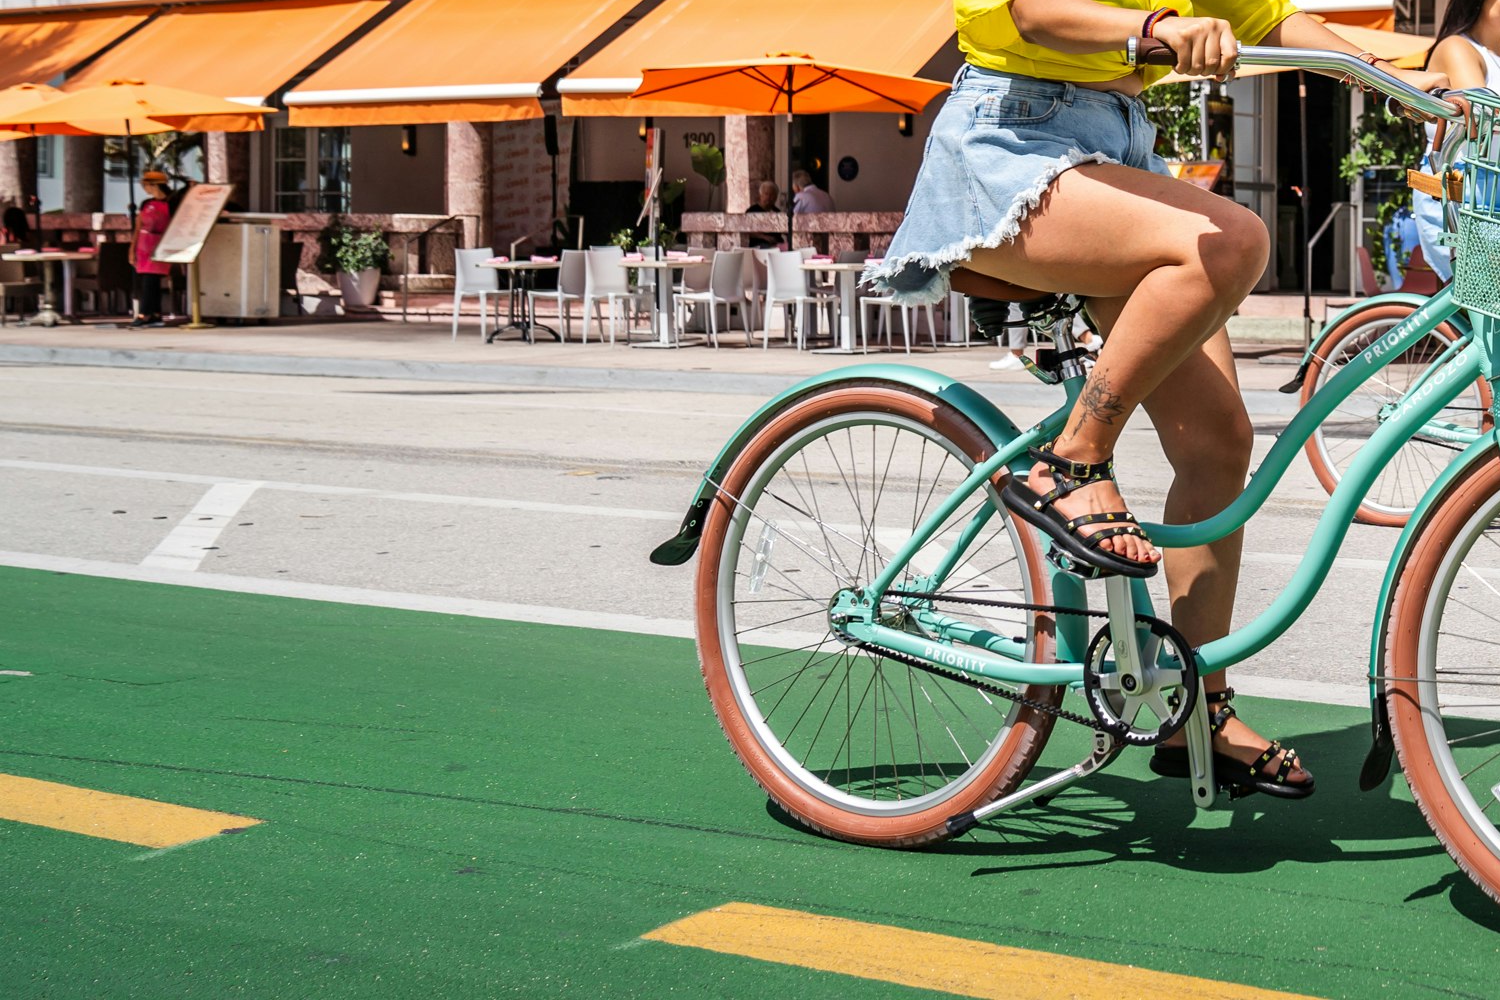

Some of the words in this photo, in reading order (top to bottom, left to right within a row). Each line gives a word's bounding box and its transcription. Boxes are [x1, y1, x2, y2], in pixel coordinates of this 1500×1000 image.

[1363, 307, 1431, 364] PRIORITY
[1391, 352, 1468, 422] CARDOZO
[925, 646, 986, 673] PRIORITY
